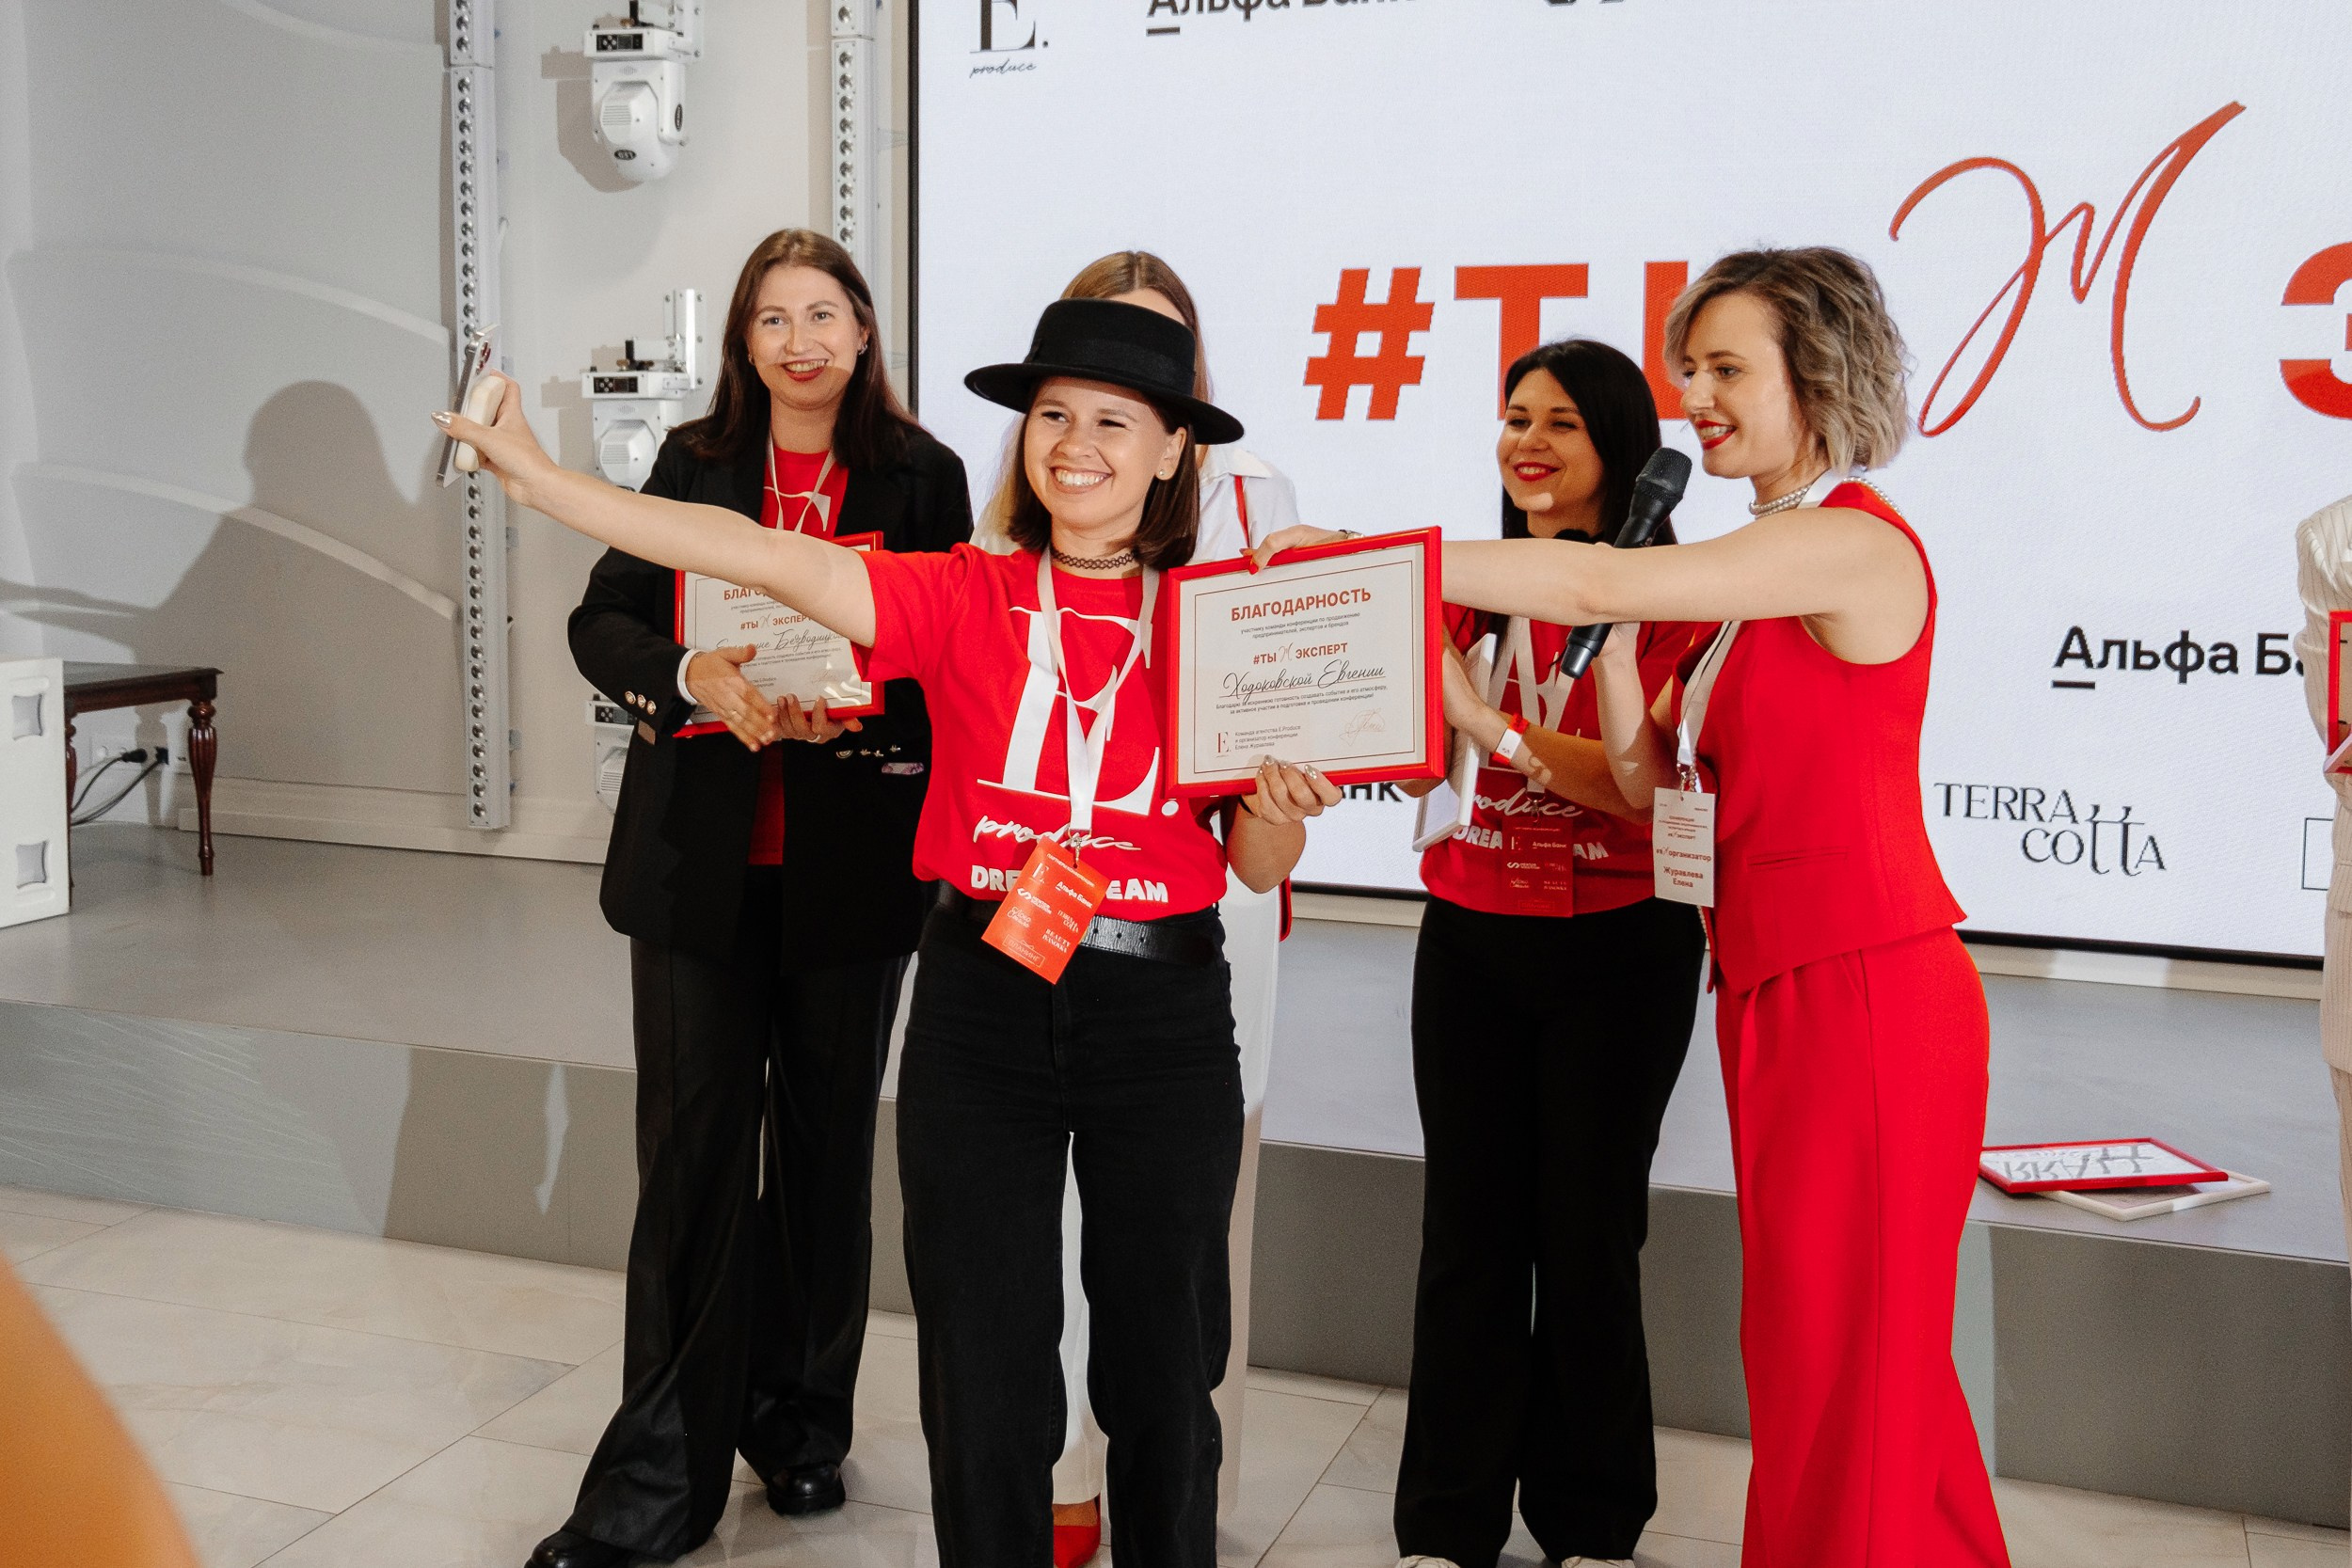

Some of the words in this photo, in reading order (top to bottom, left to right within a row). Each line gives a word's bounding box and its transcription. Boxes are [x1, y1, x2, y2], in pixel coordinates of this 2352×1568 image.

[969, 58, 1036, 79] produce
[1231, 587, 1371, 622] БЛАГОДАРНОСТЬ
[740, 620, 758, 629] #ТЫ
[1286, 618, 1318, 626] конференции
[1326, 611, 1360, 622] продвижению
[1253, 652, 1277, 665] #ТЫ
[1295, 642, 1348, 659] ЭКСПЕРТ
[2052, 626, 2239, 685] Альфа
[1317, 658, 1385, 689] Евгении
[1934, 783, 2079, 825] TERRA
[1663, 865, 1704, 879] Журавлева
[1673, 878, 1693, 888] Елена
[971, 864, 1023, 893] DRE
[1105, 878, 1169, 903] EAM
[1057, 880, 1077, 899] Альфа
